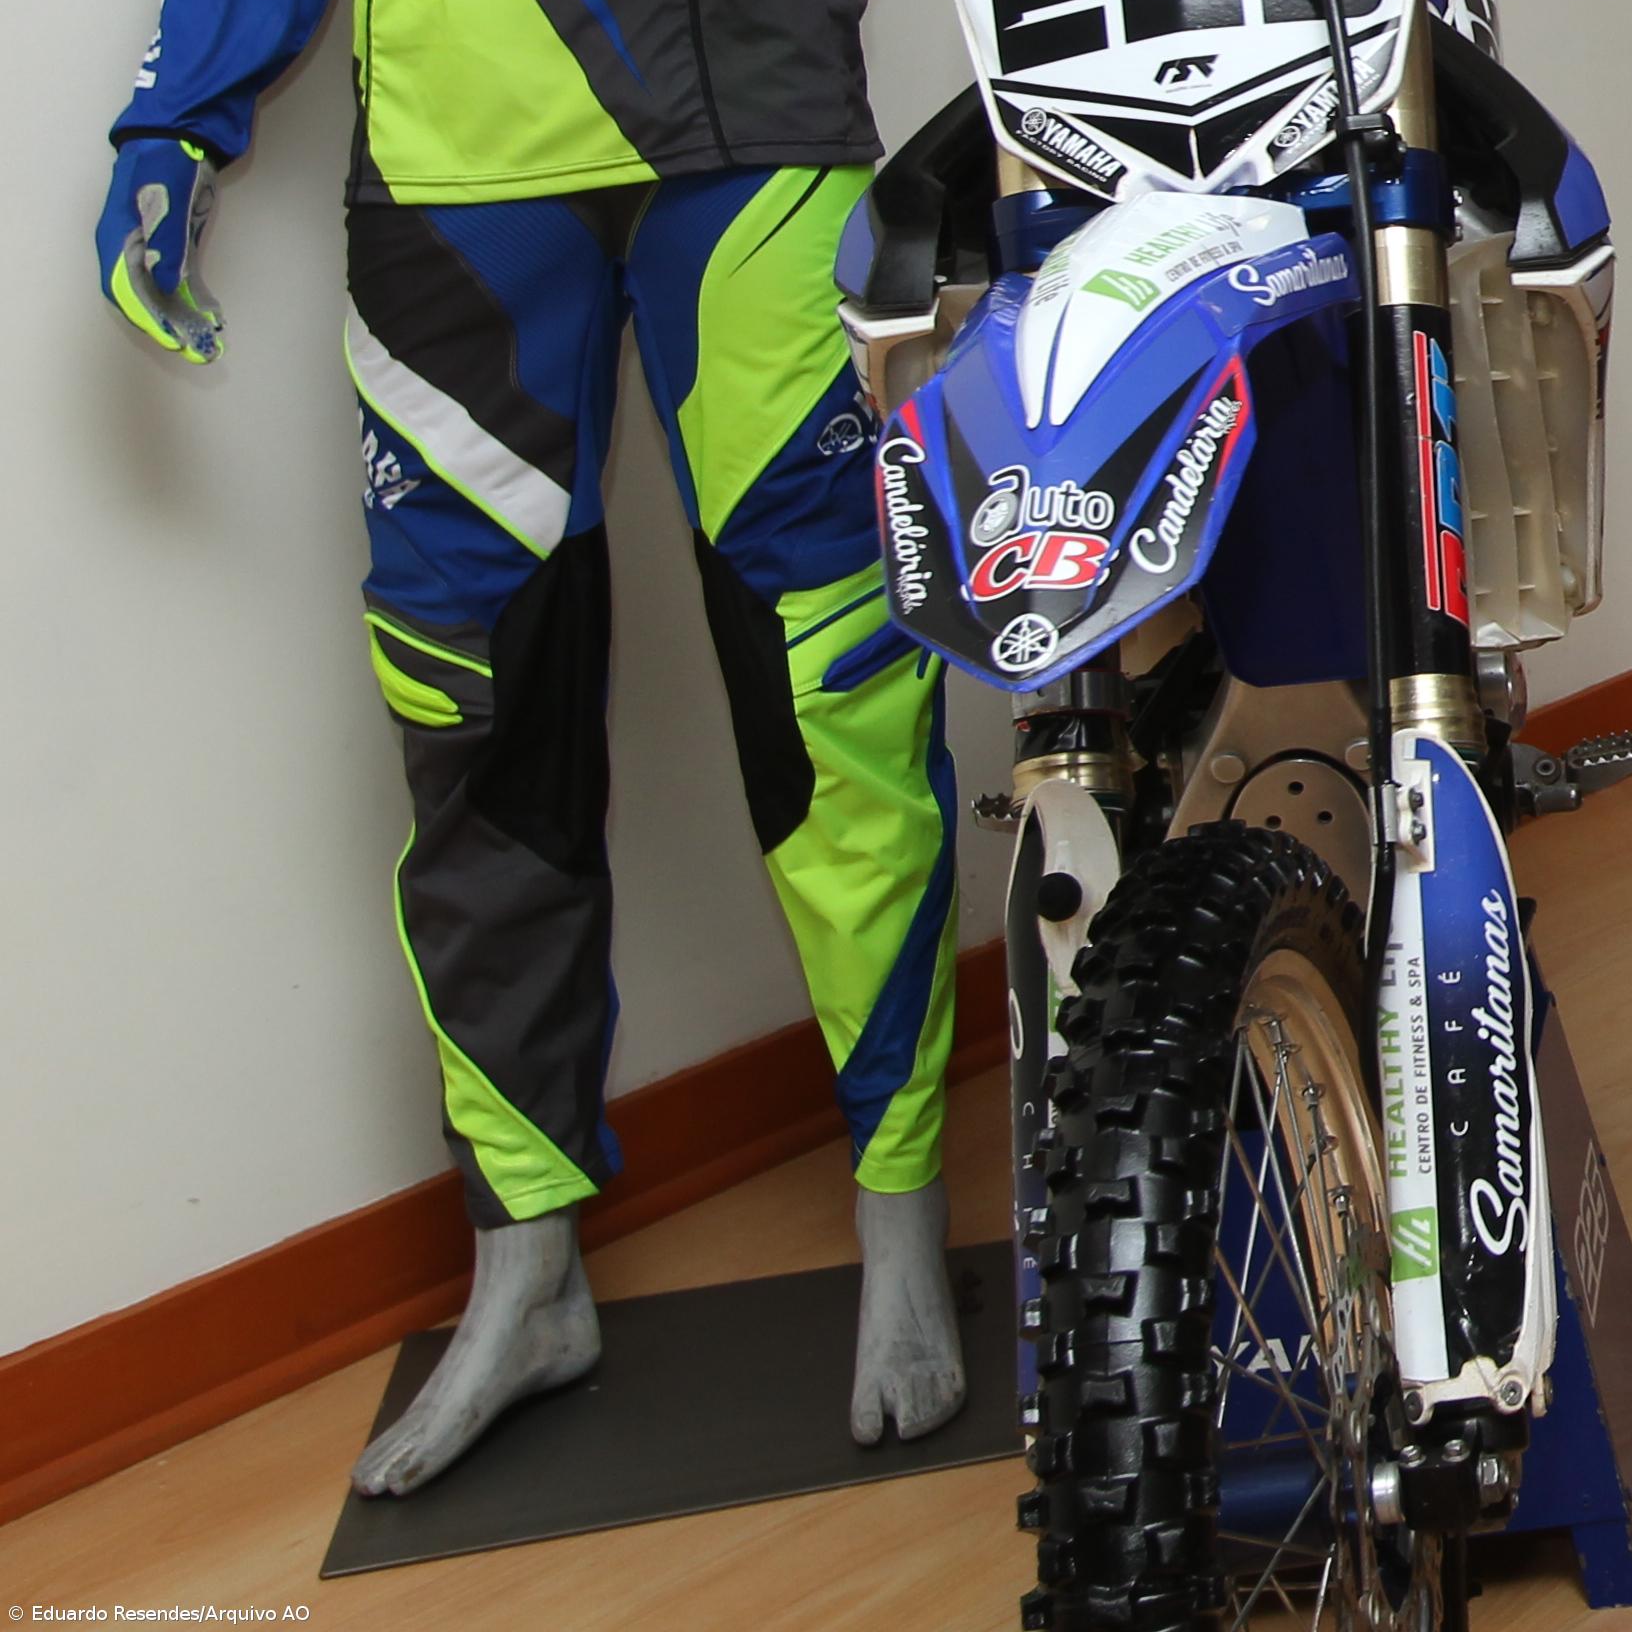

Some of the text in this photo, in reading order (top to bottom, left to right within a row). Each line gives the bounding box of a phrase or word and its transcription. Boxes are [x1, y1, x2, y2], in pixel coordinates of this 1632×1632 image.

[1041, 117, 1123, 177] YAMAHA
[962, 530, 1119, 602] CB
[1378, 1002, 1408, 1179] HEALTHY
[1407, 956, 1432, 1176] CENTRO DE FITNESS & SPA
[1437, 970, 1470, 1138] CAFÉ
[1470, 888, 1530, 1257] Samaritanas
